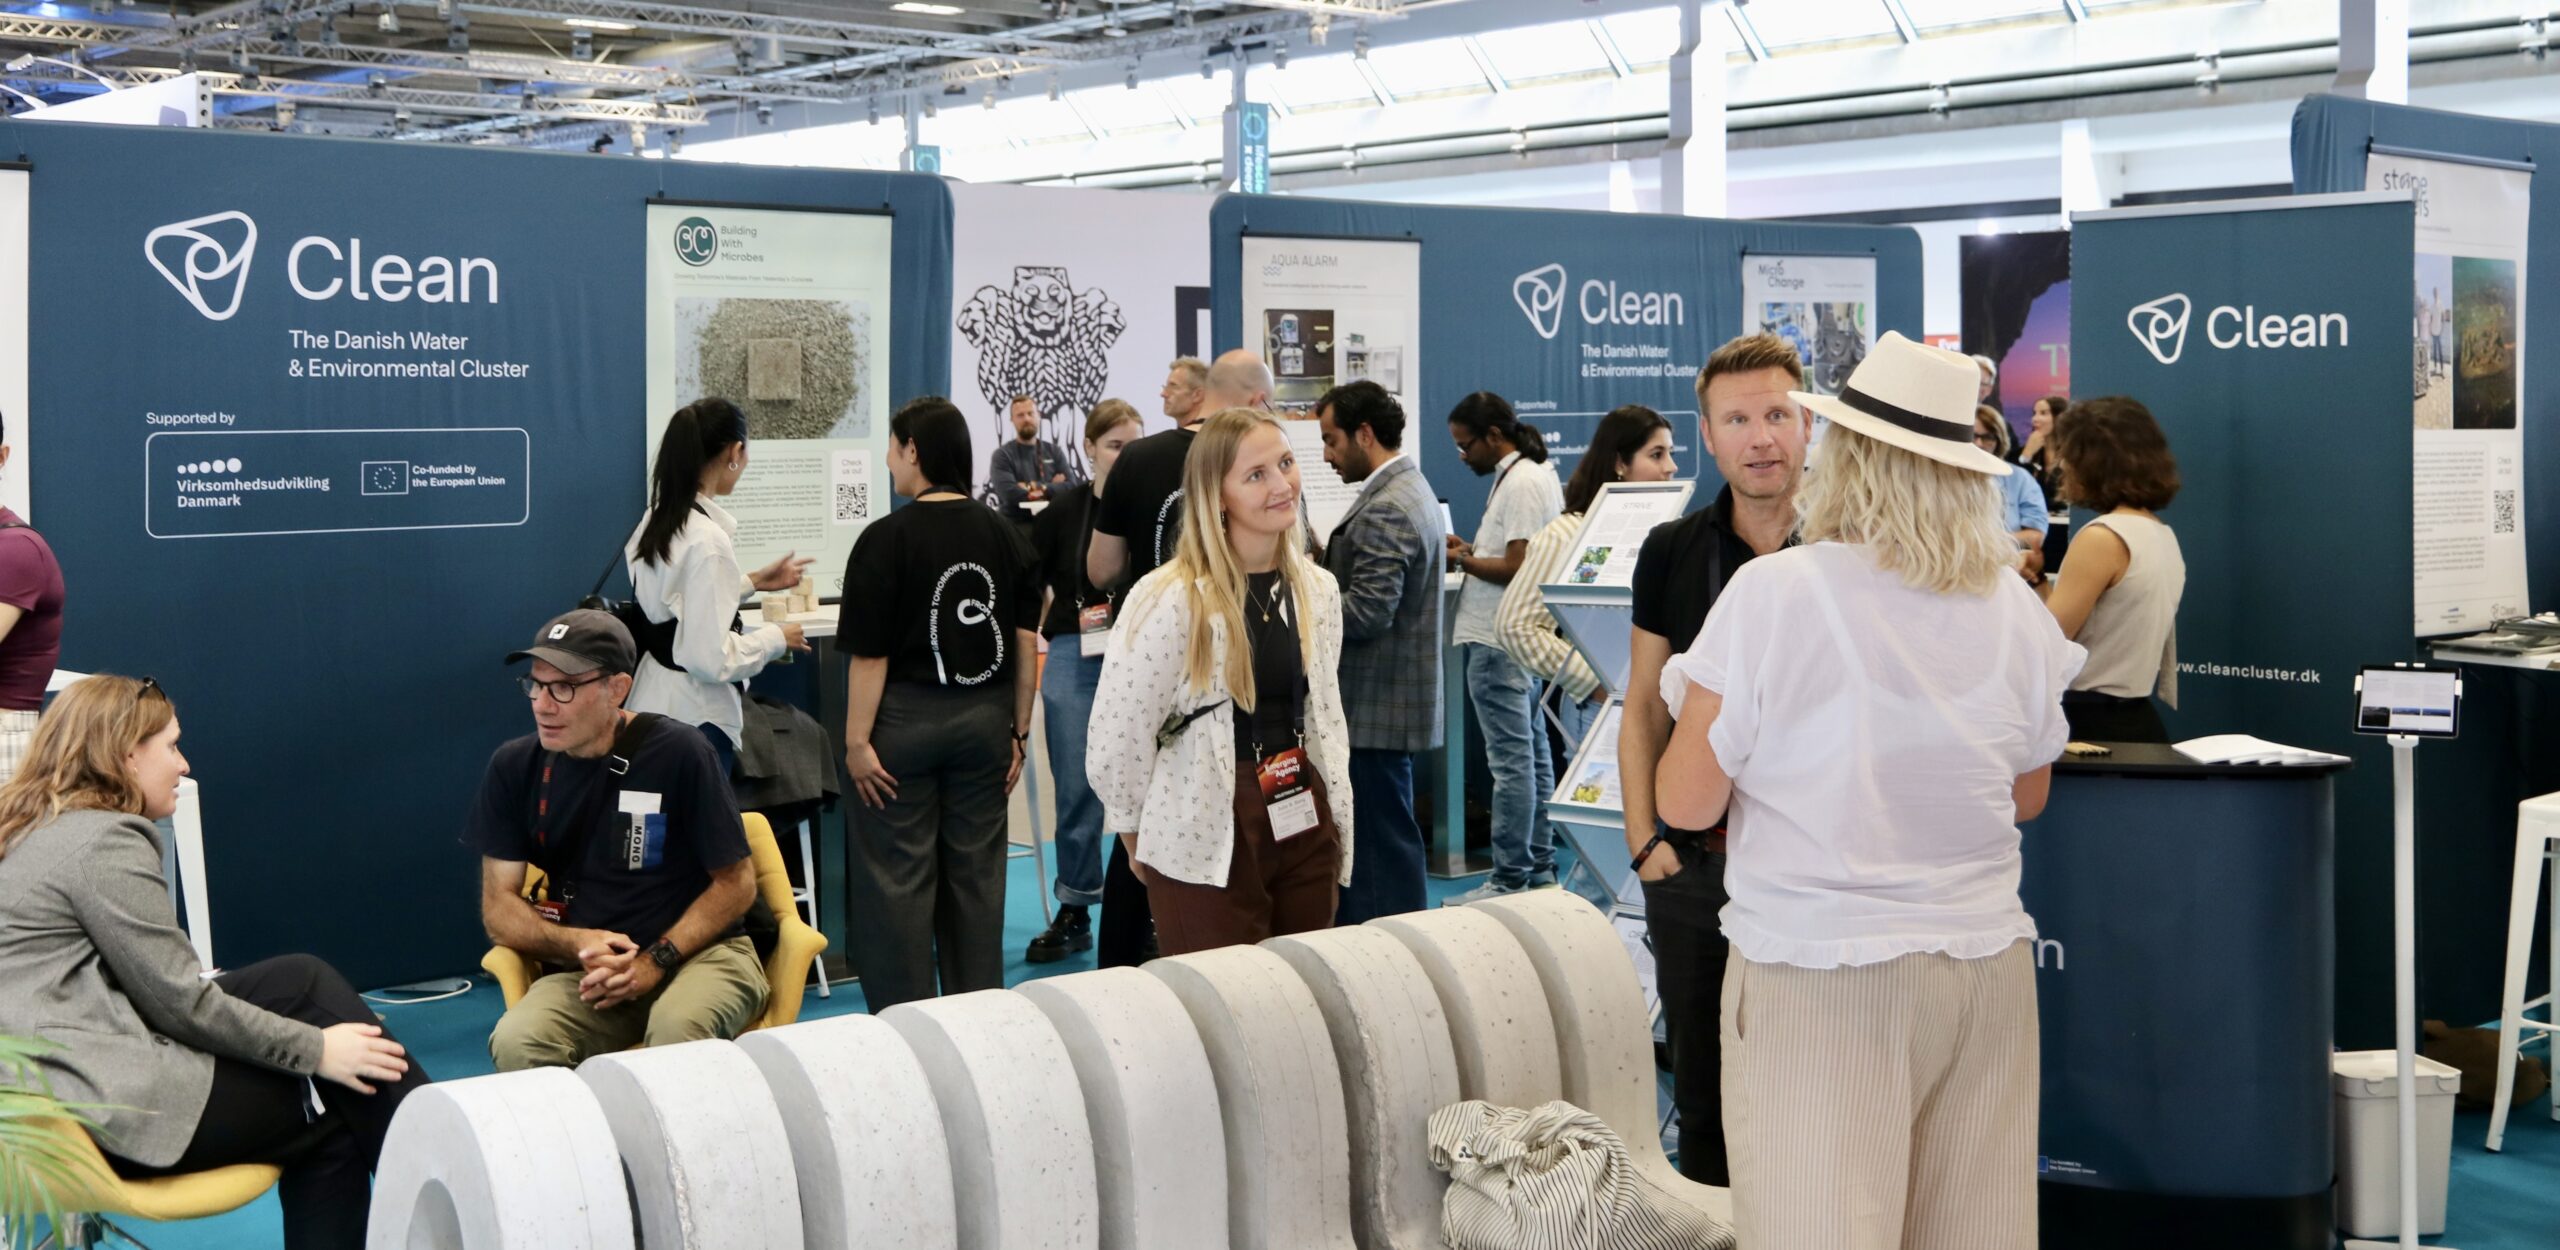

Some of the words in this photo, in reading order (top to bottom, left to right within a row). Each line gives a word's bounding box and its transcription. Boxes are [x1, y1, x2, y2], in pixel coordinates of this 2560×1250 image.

[720, 225, 758, 238] Building
[721, 239, 743, 249] With
[721, 252, 764, 263] Microbes
[1271, 254, 1299, 267] AQUA
[1302, 255, 1339, 267] ALARM
[287, 235, 498, 304] Clean
[1758, 264, 1784, 276] Micro
[1768, 277, 1804, 290] Change
[1580, 279, 1684, 325] Clean
[2206, 304, 2348, 349] Clean
[288, 329, 329, 349] The
[335, 330, 405, 349] Danish
[410, 331, 468, 350] Water
[1581, 343, 1601, 358] The
[1603, 343, 1638, 358] Danish
[1639, 344, 1669, 358] Water
[288, 359, 304, 377] &
[309, 358, 455, 378] Environmental
[460, 359, 530, 378] Cluster
[1581, 363, 1589, 377] &
[1590, 363, 1662, 377] Environmental
[1664, 363, 1698, 377] Cluster
[1514, 400, 1549, 410] Supported
[146, 411, 217, 426] Supported
[219, 412, 236, 426] by
[412, 464, 463, 475] Co-funded
[464, 464, 476, 476] by
[176, 476, 331, 493] Virksomhedsudvikling
[412, 478, 428, 487] the
[430, 477, 476, 488] European
[477, 476, 506, 486] Union
[177, 494, 241, 508] Danmark
[1158, 488, 1185, 523] TOMORRO
[1154, 525, 1164, 567] GROWING
[931, 562, 967, 606] TOMORROW'S
[968, 562, 996, 600] MATERIALS
[970, 599, 991, 617] FROM
[930, 609, 939, 653] GROWING
[2176, 661, 2321, 684] w.cleancluster.dk
[632, 825, 642, 863] MONO
